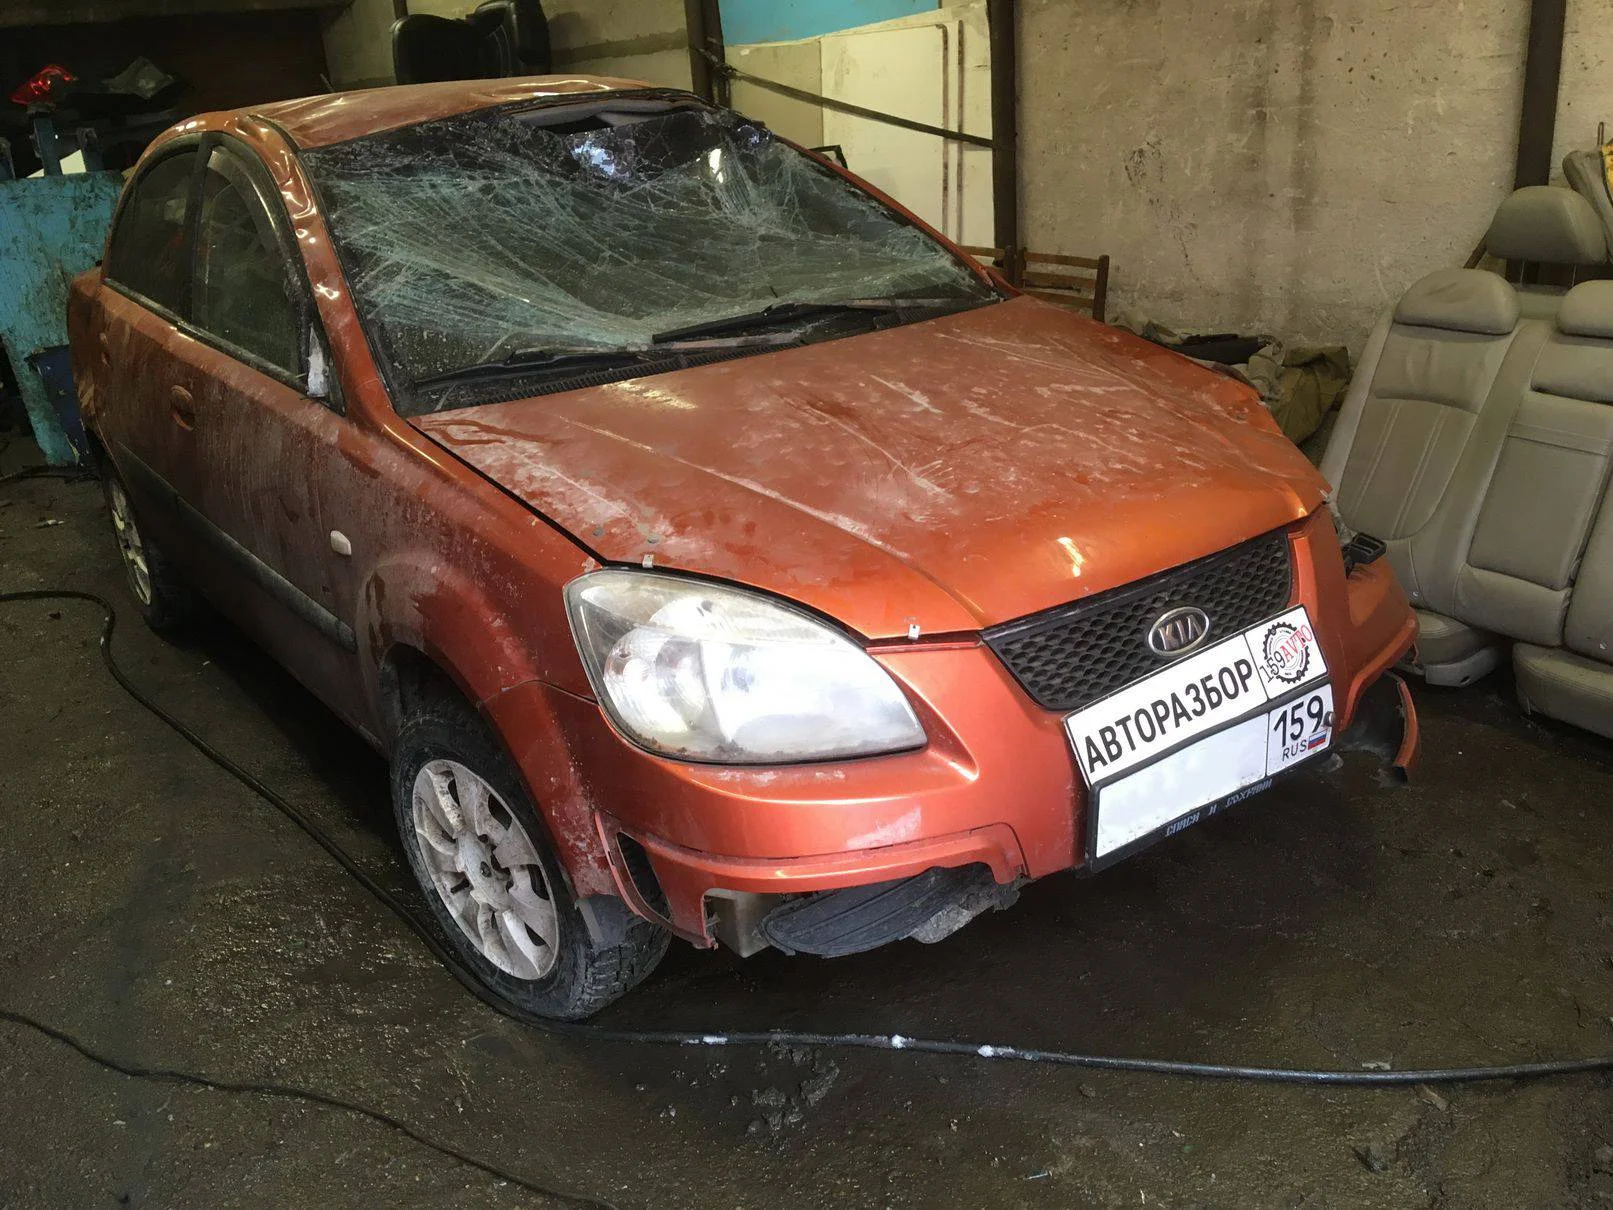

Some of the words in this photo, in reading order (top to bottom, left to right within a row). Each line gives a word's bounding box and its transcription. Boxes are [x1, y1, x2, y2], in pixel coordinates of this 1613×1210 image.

[1158, 614, 1202, 650] KIA
[1083, 658, 1253, 773] АВТОРАЗБОР
[1273, 695, 1324, 748] 159
[1282, 739, 1307, 762] RUS
